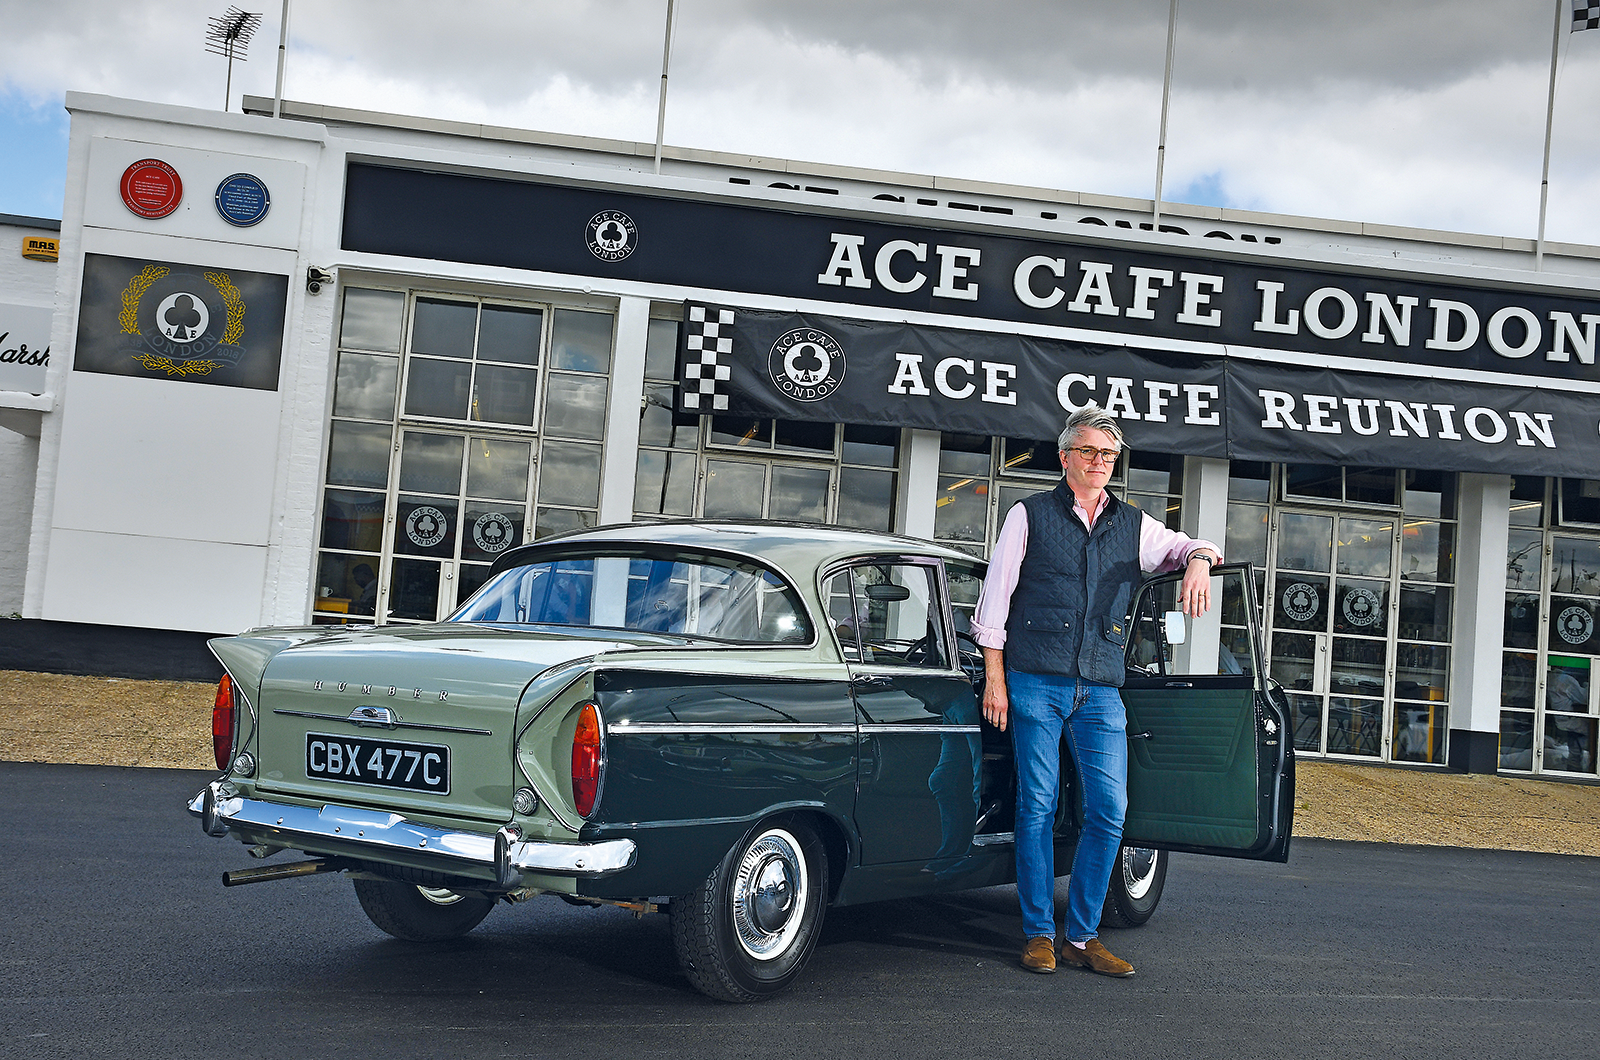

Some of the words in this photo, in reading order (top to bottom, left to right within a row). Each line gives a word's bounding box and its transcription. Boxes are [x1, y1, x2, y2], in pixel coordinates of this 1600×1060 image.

[591, 213, 609, 230] ACE
[613, 213, 635, 234] CAFE
[590, 240, 632, 260] LONDON
[818, 233, 980, 301] ACE
[1013, 254, 1223, 327] CAFE
[1253, 280, 1600, 365] LONDON
[143, 325, 217, 357] LONDON
[776, 332, 803, 355] ACE
[807, 332, 841, 359] CAFE
[217, 347, 239, 359] 2018
[775, 373, 837, 399] LONDON
[794, 374, 818, 382] ACE
[887, 352, 1018, 406] ACE
[1055, 372, 1221, 427] CAFE
[1258, 389, 1557, 449] REUNION
[409, 508, 425, 523] ACE
[427, 508, 446, 525] CAFE
[476, 515, 492, 529] ACE
[493, 514, 512, 531] CAFE
[408, 530, 443, 545] LONDON
[476, 537, 510, 551] LONDON
[314, 680, 449, 701] HUMBER
[310, 741, 361, 777] CBX
[367, 747, 442, 785] 477C
